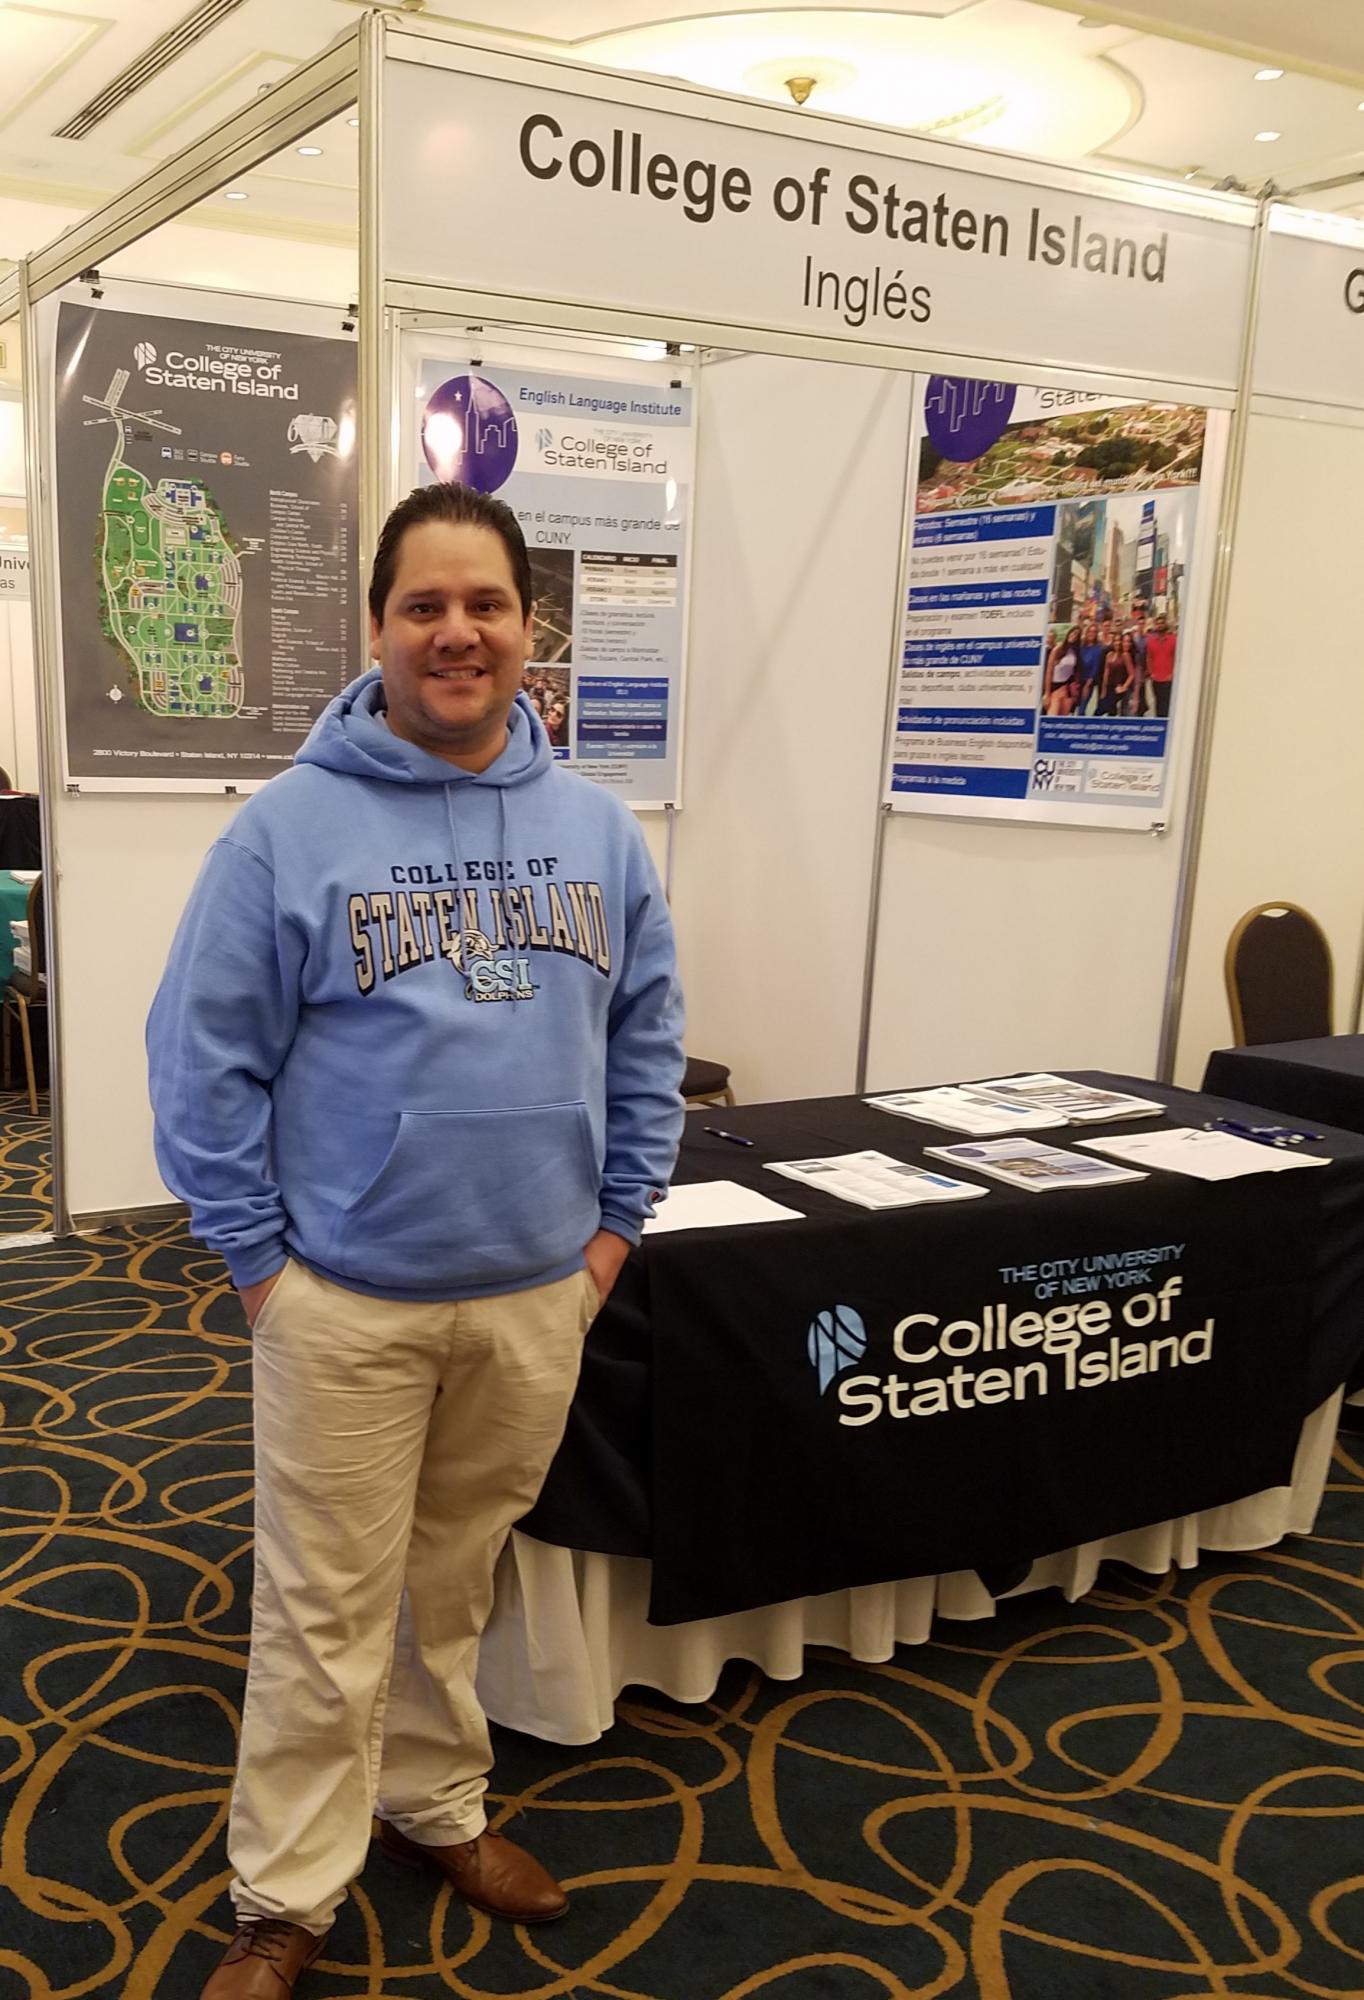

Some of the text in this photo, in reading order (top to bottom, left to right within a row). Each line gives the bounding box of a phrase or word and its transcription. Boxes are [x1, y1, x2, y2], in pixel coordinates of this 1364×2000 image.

[520, 113, 1168, 283] College of Staten Island
[803, 256, 931, 326] Inglés
[166, 352, 282, 380] College of
[145, 367, 298, 400] Staten Island
[520, 387, 681, 416] English Language Institute
[544, 450, 667, 474] Staten Island
[560, 436, 653, 458] College of
[518, 511, 532, 521] en
[535, 511, 545, 523] el
[548, 513, 592, 527] campus
[595, 515, 618, 528] más
[621, 518, 661, 531] grande
[390, 857, 559, 884] COLLEGE OF
[347, 881, 612, 997] STATEN ISLAND
[469, 958, 533, 993] CSI
[998, 1243, 1186, 1284] THE CITY UNIVERSITY
[1035, 1268, 1153, 1300] OF NEW YORK
[893, 1275, 1183, 1364] College of
[837, 1318, 1215, 1427] Staten Island
